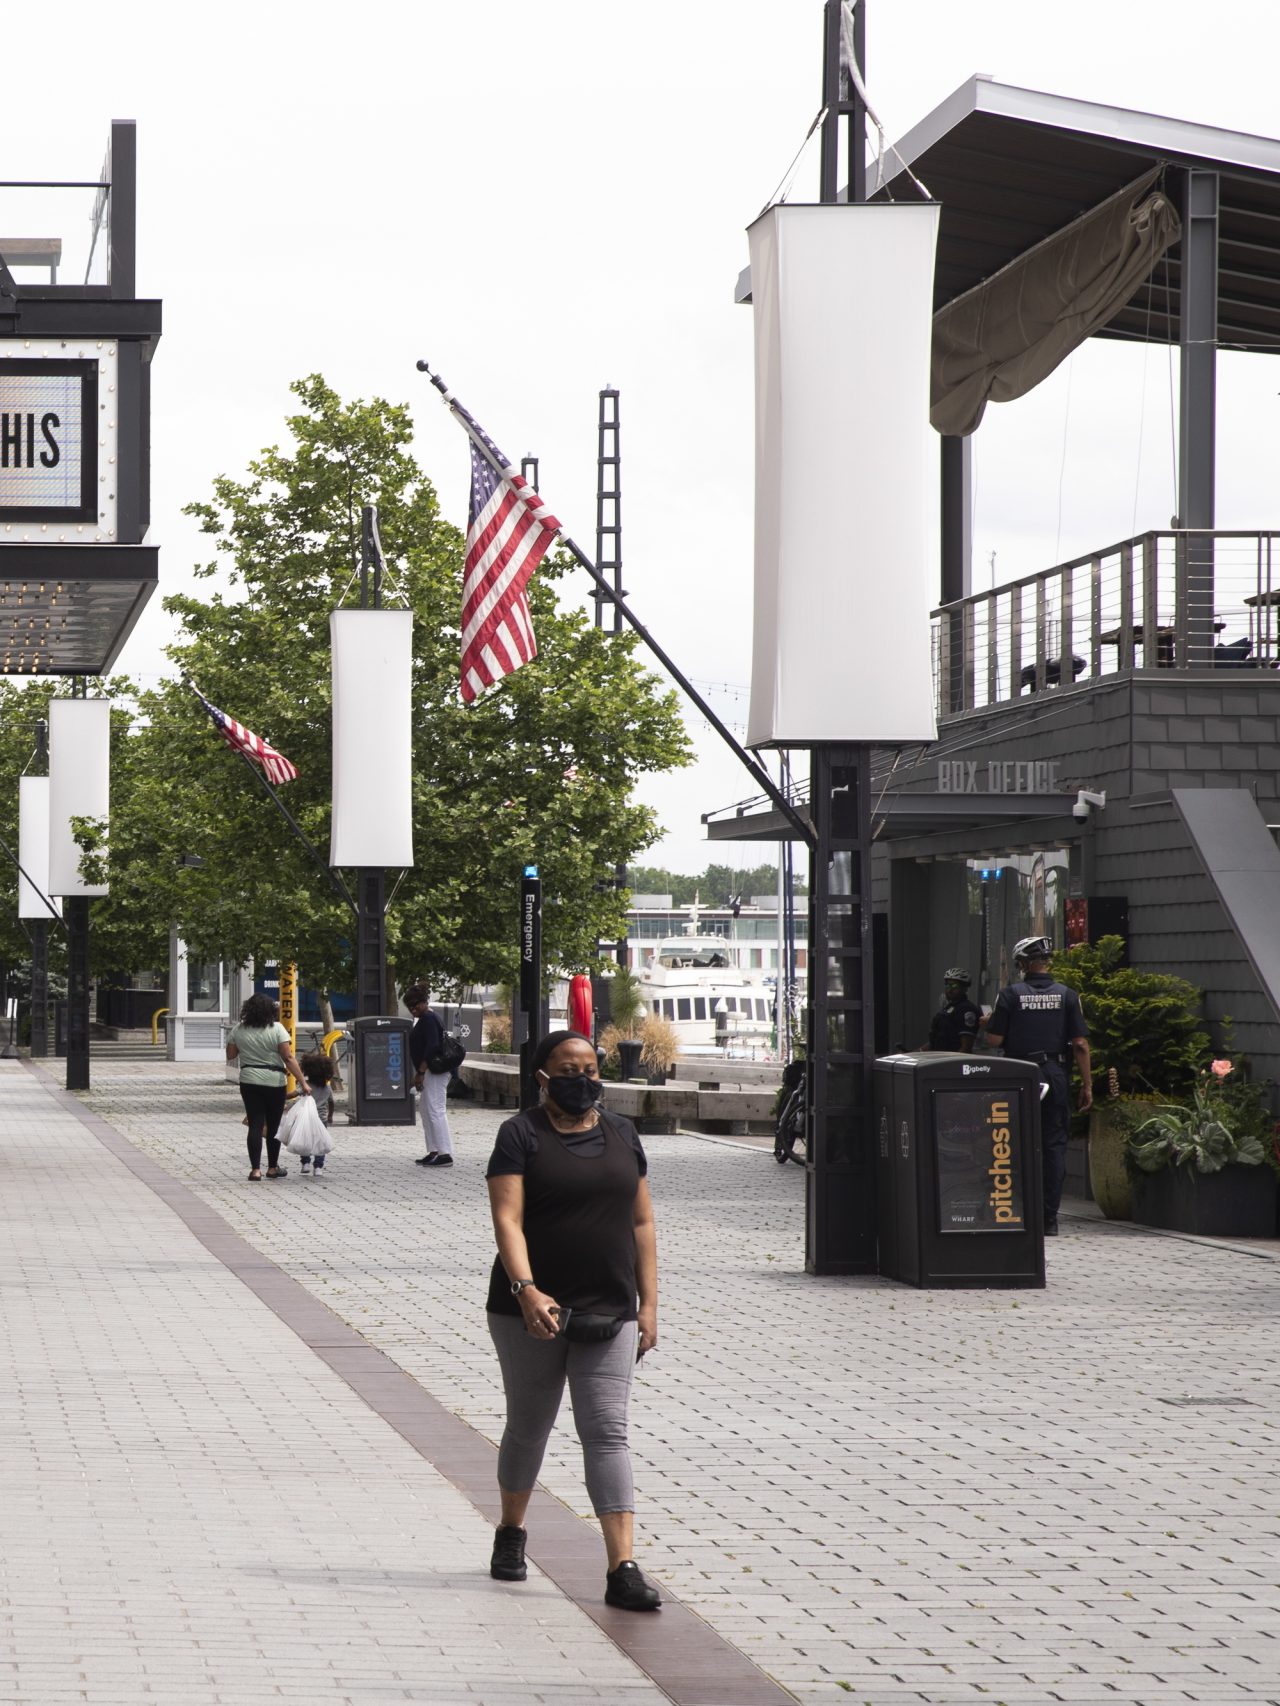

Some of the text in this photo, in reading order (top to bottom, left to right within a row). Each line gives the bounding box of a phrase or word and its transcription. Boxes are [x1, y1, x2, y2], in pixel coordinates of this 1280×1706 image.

[938, 761, 1060, 793] BOX OFFICE
[524, 894, 535, 962] Emergency
[1022, 1002, 1061, 1010] POLICE
[386, 1033, 402, 1081] clean
[987, 1102, 1023, 1223] pitches in
